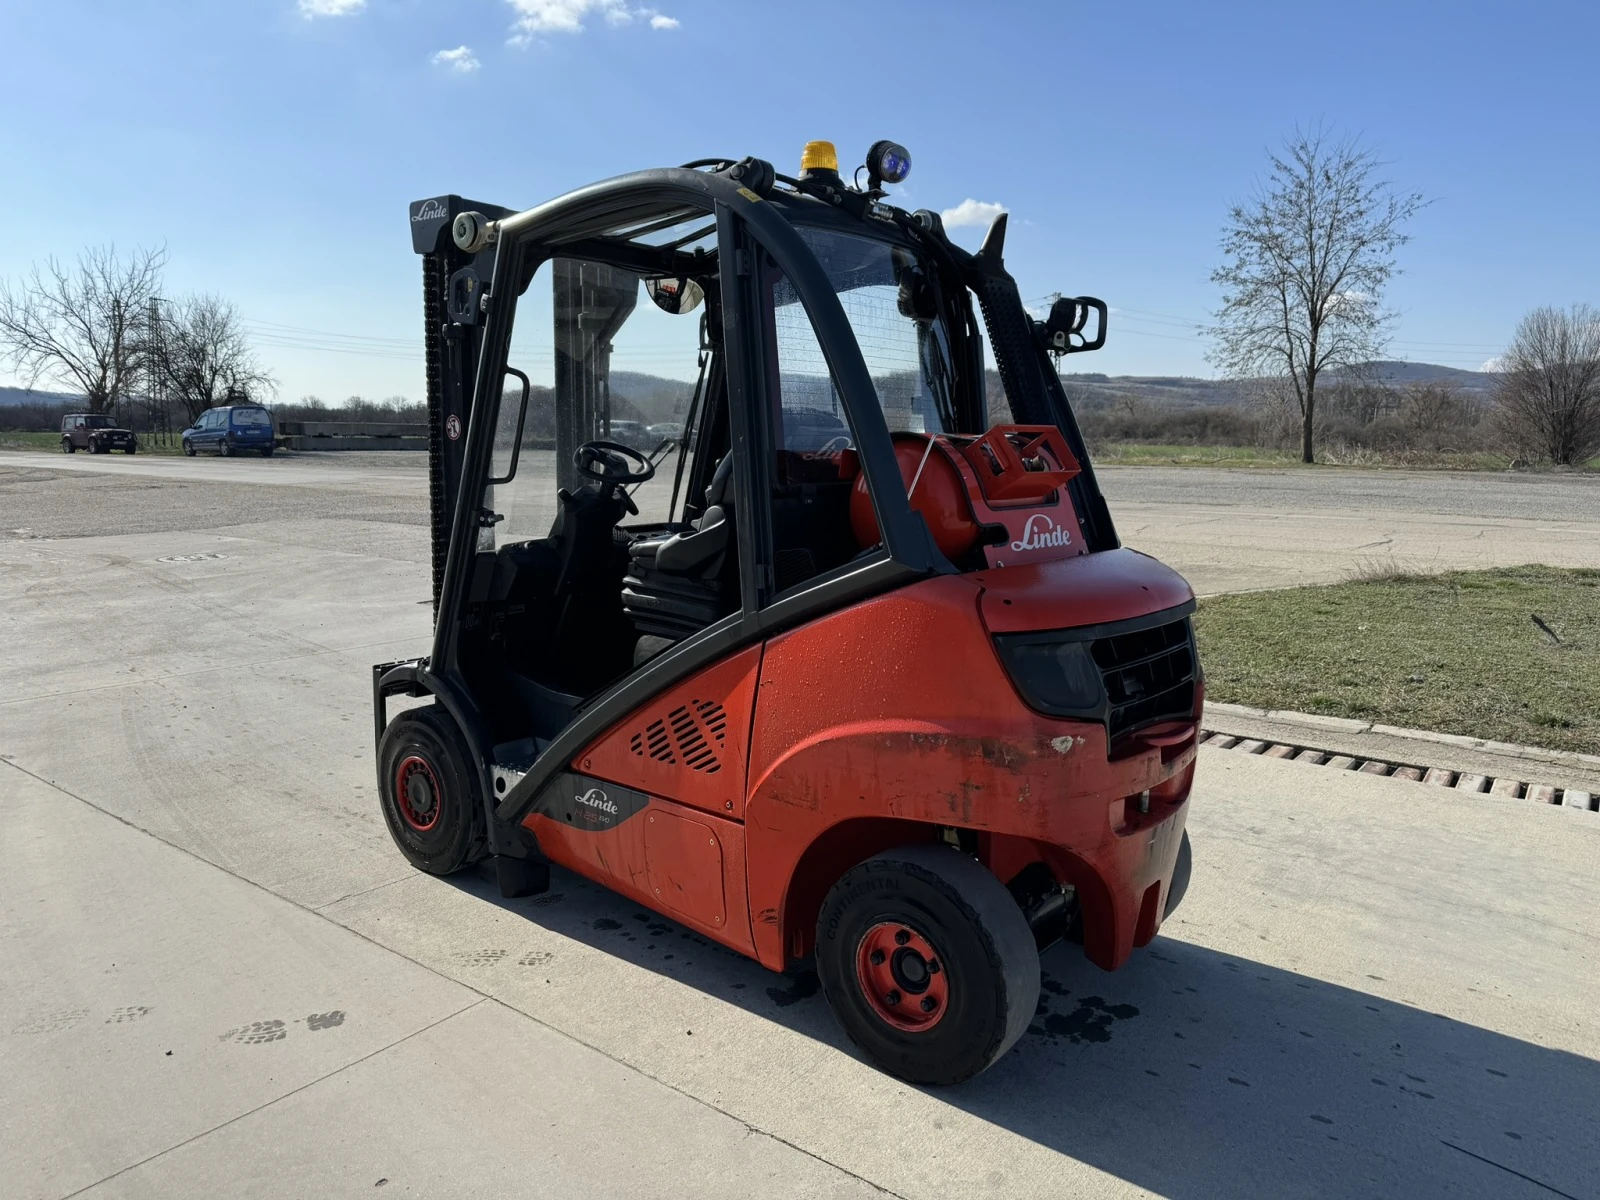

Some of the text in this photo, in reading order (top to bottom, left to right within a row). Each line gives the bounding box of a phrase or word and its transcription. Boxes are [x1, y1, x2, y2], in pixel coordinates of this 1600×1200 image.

[411, 199, 447, 222] Linde
[1010, 513, 1072, 552] Linde
[574, 788, 618, 815] Linde
[826, 877, 902, 941] CONTINENTAL
